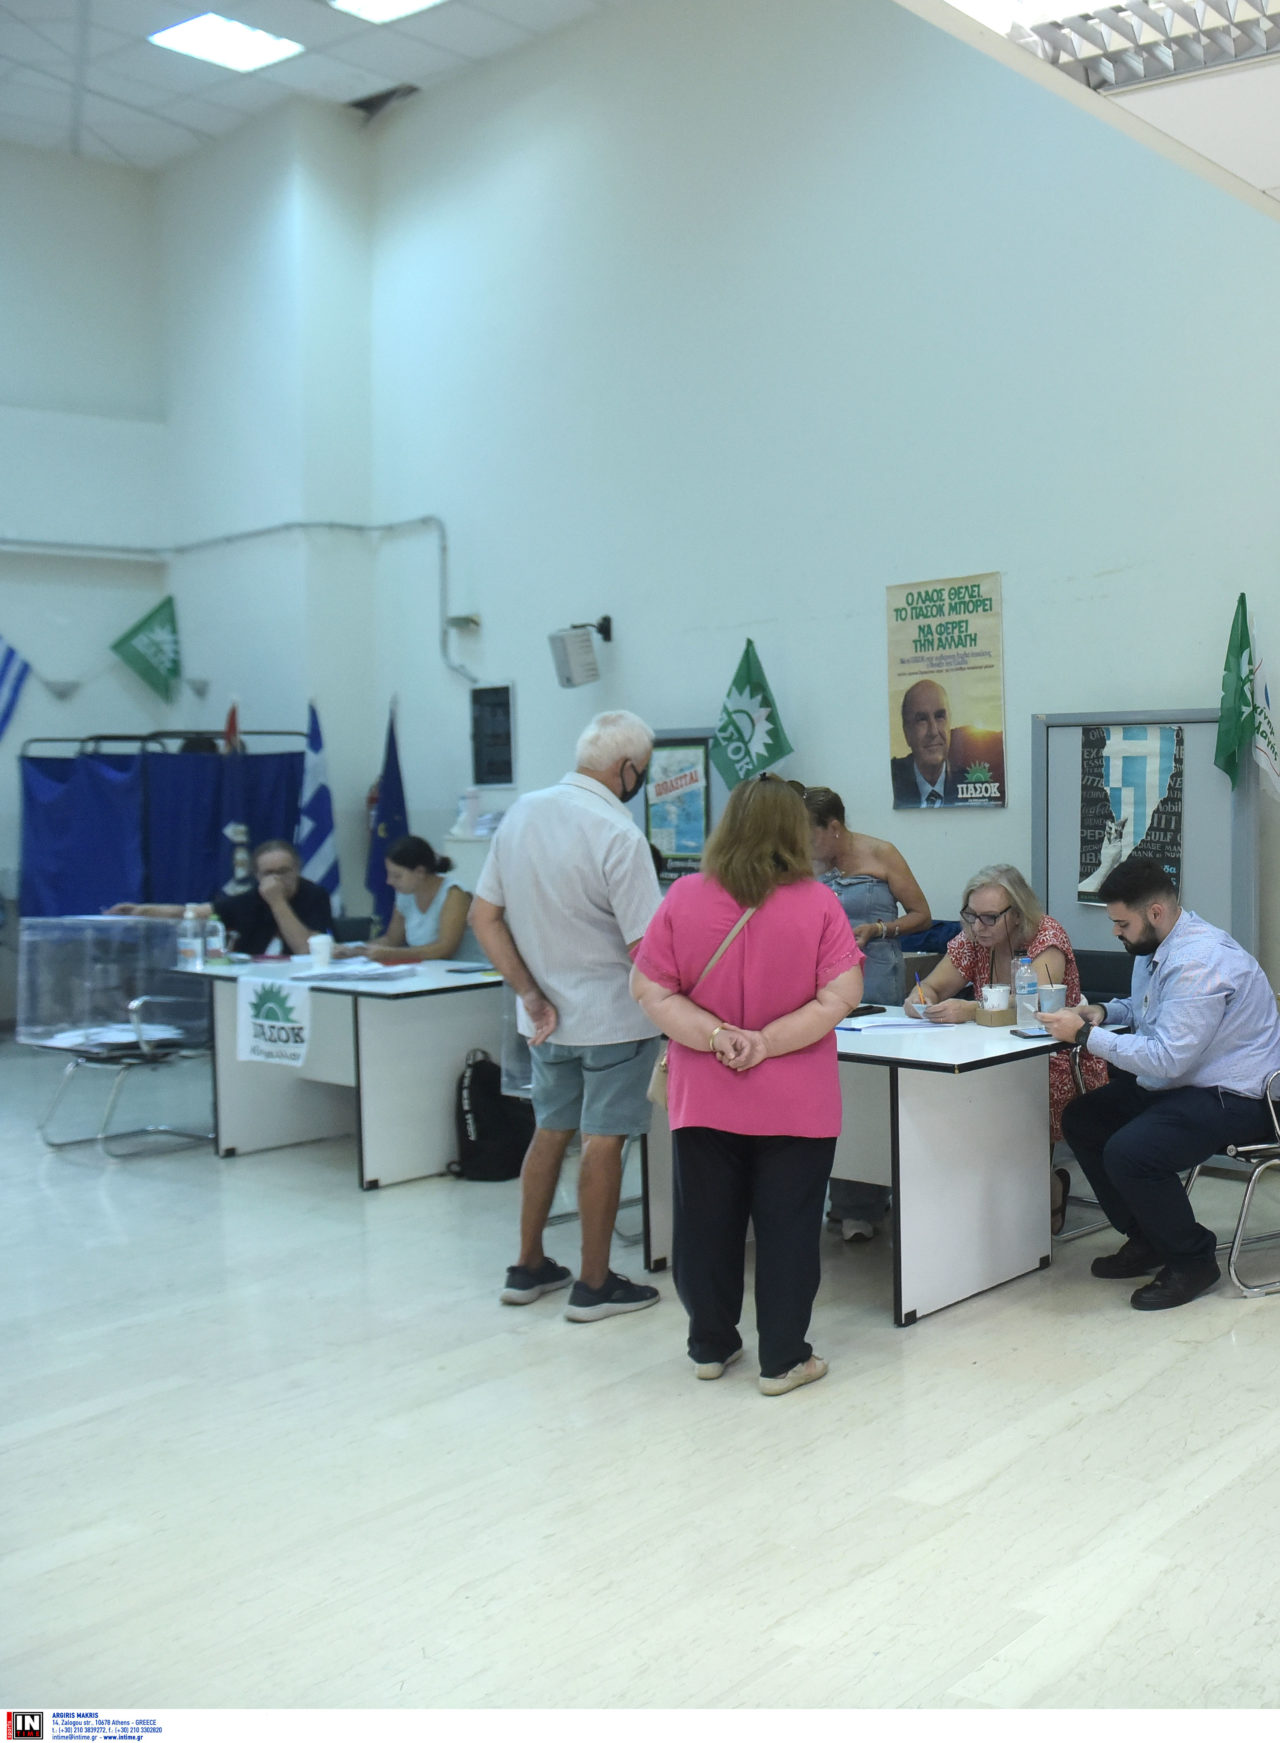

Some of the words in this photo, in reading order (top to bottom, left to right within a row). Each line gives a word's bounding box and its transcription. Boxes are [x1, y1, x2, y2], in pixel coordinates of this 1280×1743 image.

[916, 588, 946, 605] ΛΑΟΣ
[894, 608, 908, 621] ΤΟ
[911, 603, 945, 620] ΠΑΣΟΚ
[948, 598, 992, 618] ΜΠΟΡΕΙ
[918, 624, 933, 638] ΝΑ
[936, 619, 969, 636] ΦΕΡΕΙ
[913, 638, 935, 653] ΤΗΝ
[937, 633, 977, 651] ΑΛΛΑΓΗ
[957, 783, 1001, 798] ΠΑΣΟΚ
